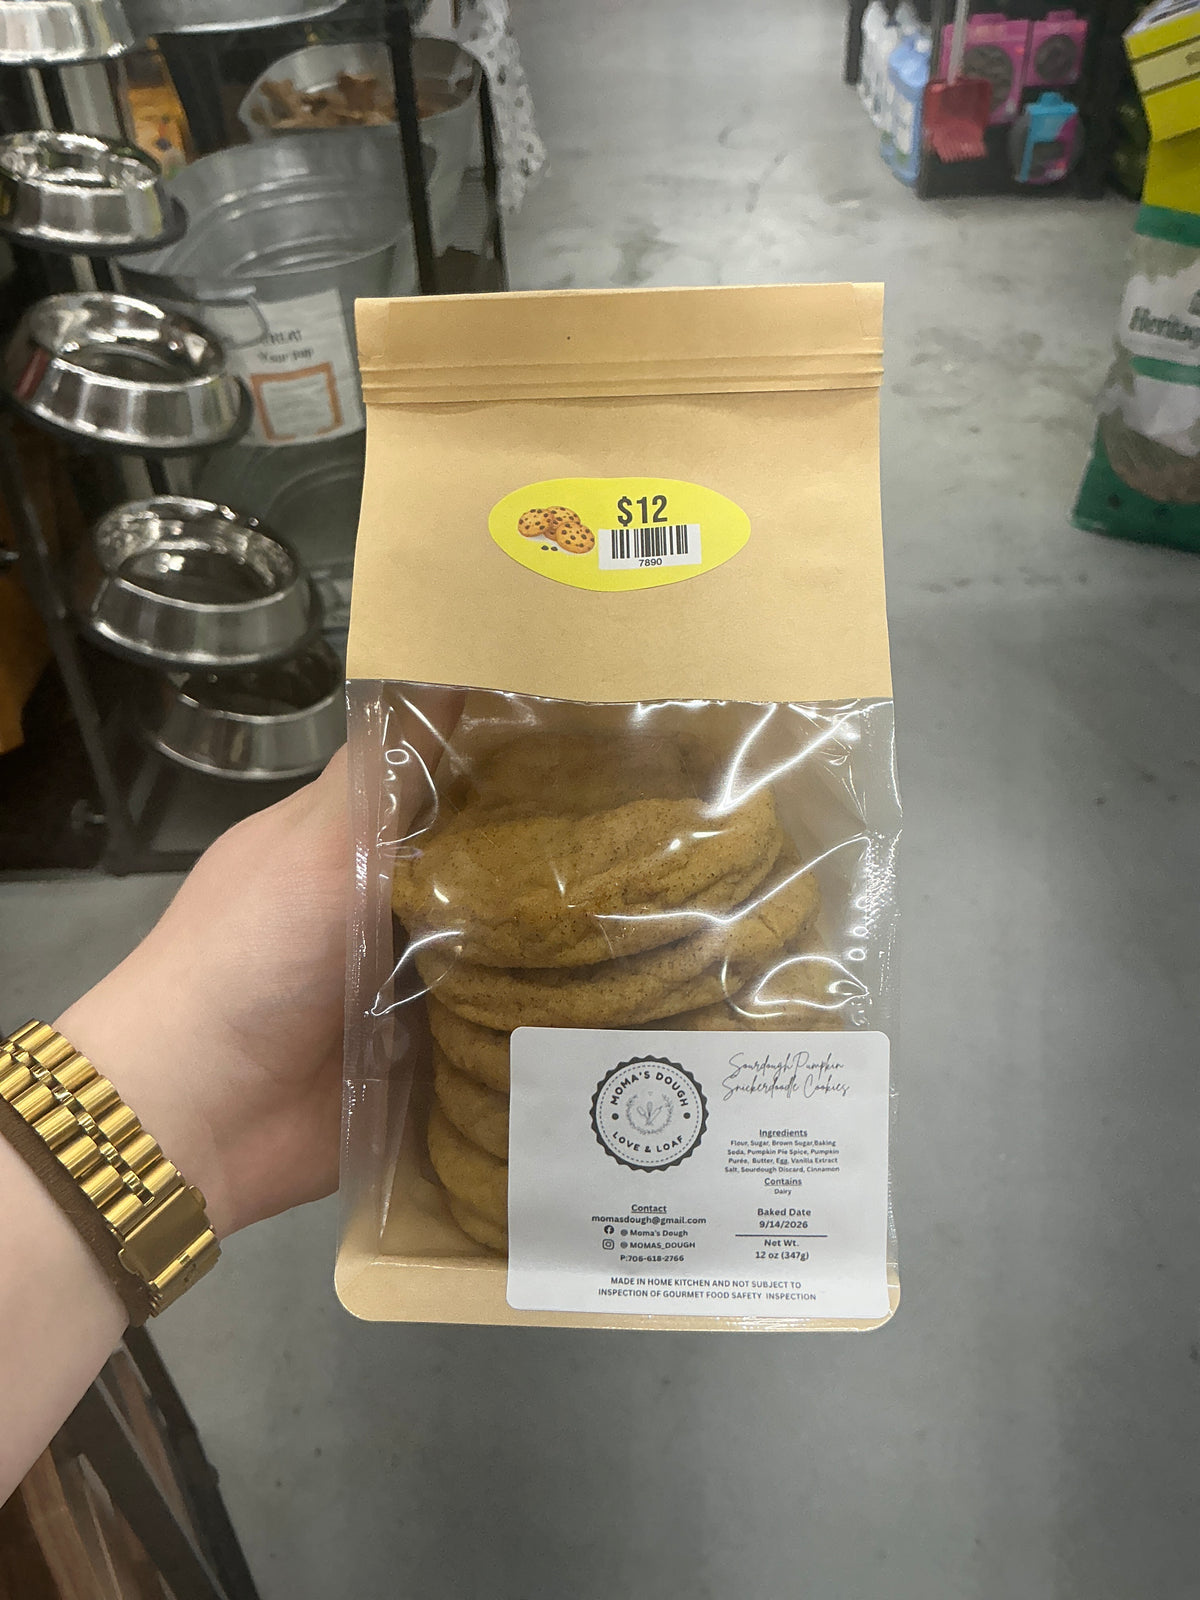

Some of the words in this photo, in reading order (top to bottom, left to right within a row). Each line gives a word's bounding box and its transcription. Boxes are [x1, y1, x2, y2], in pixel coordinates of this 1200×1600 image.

[617, 494, 668, 527] $12
[638, 557, 663, 568] 7890
[728, 1052, 792, 1080] Sourdough
[792, 1051, 844, 1081] Pumpkin
[610, 1070, 651, 1106] MOMA'S
[655, 1071, 689, 1107] DOUGH
[803, 1073, 850, 1098] Cookies
[759, 1129, 808, 1138] Ingredients
[612, 1131, 641, 1152] LOVE
[644, 1145, 652, 1153] &
[656, 1135, 683, 1153] LOAF
[752, 1157, 775, 1165] Butter,
[741, 1166, 777, 1174] Sourdough
[764, 1177, 802, 1187] Contains
[774, 1188, 792, 1196] Dairy
[631, 1203, 667, 1213] Contact
[757, 1208, 786, 1217] Baked
[789, 1208, 811, 1217] Date
[591, 1215, 707, 1226] momasdough@gmail.com
[759, 1220, 809, 1230] 9/14/2026
[629, 1229, 661, 1237] Moma's
[662, 1229, 689, 1238] Dough
[629, 1241, 696, 1250] MOMAS_DOUGH
[764, 1239, 782, 1247] Net
[783, 1239, 800, 1248] Wt.
[755, 1250, 766, 1259] 12
[781, 1250, 809, 1262] (347g)
[610, 1277, 635, 1286] MADE
[636, 1277, 646, 1286] IN
[647, 1278, 673, 1287] HOME
[674, 1278, 711, 1287] KITCHEN
[712, 1279, 731, 1288] AND
[732, 1280, 750, 1288] NOT
[751, 1280, 789, 1289] SUBJECT
[790, 1281, 802, 1289] TO
[598, 1288, 649, 1297] INSPECTION
[650, 1289, 661, 1297] OF
[662, 1290, 704, 1299] GOURMET
[706, 1290, 730, 1299] FOOD
[731, 1291, 762, 1300] SAFETY
[765, 1292, 817, 1301] INSPECTION
